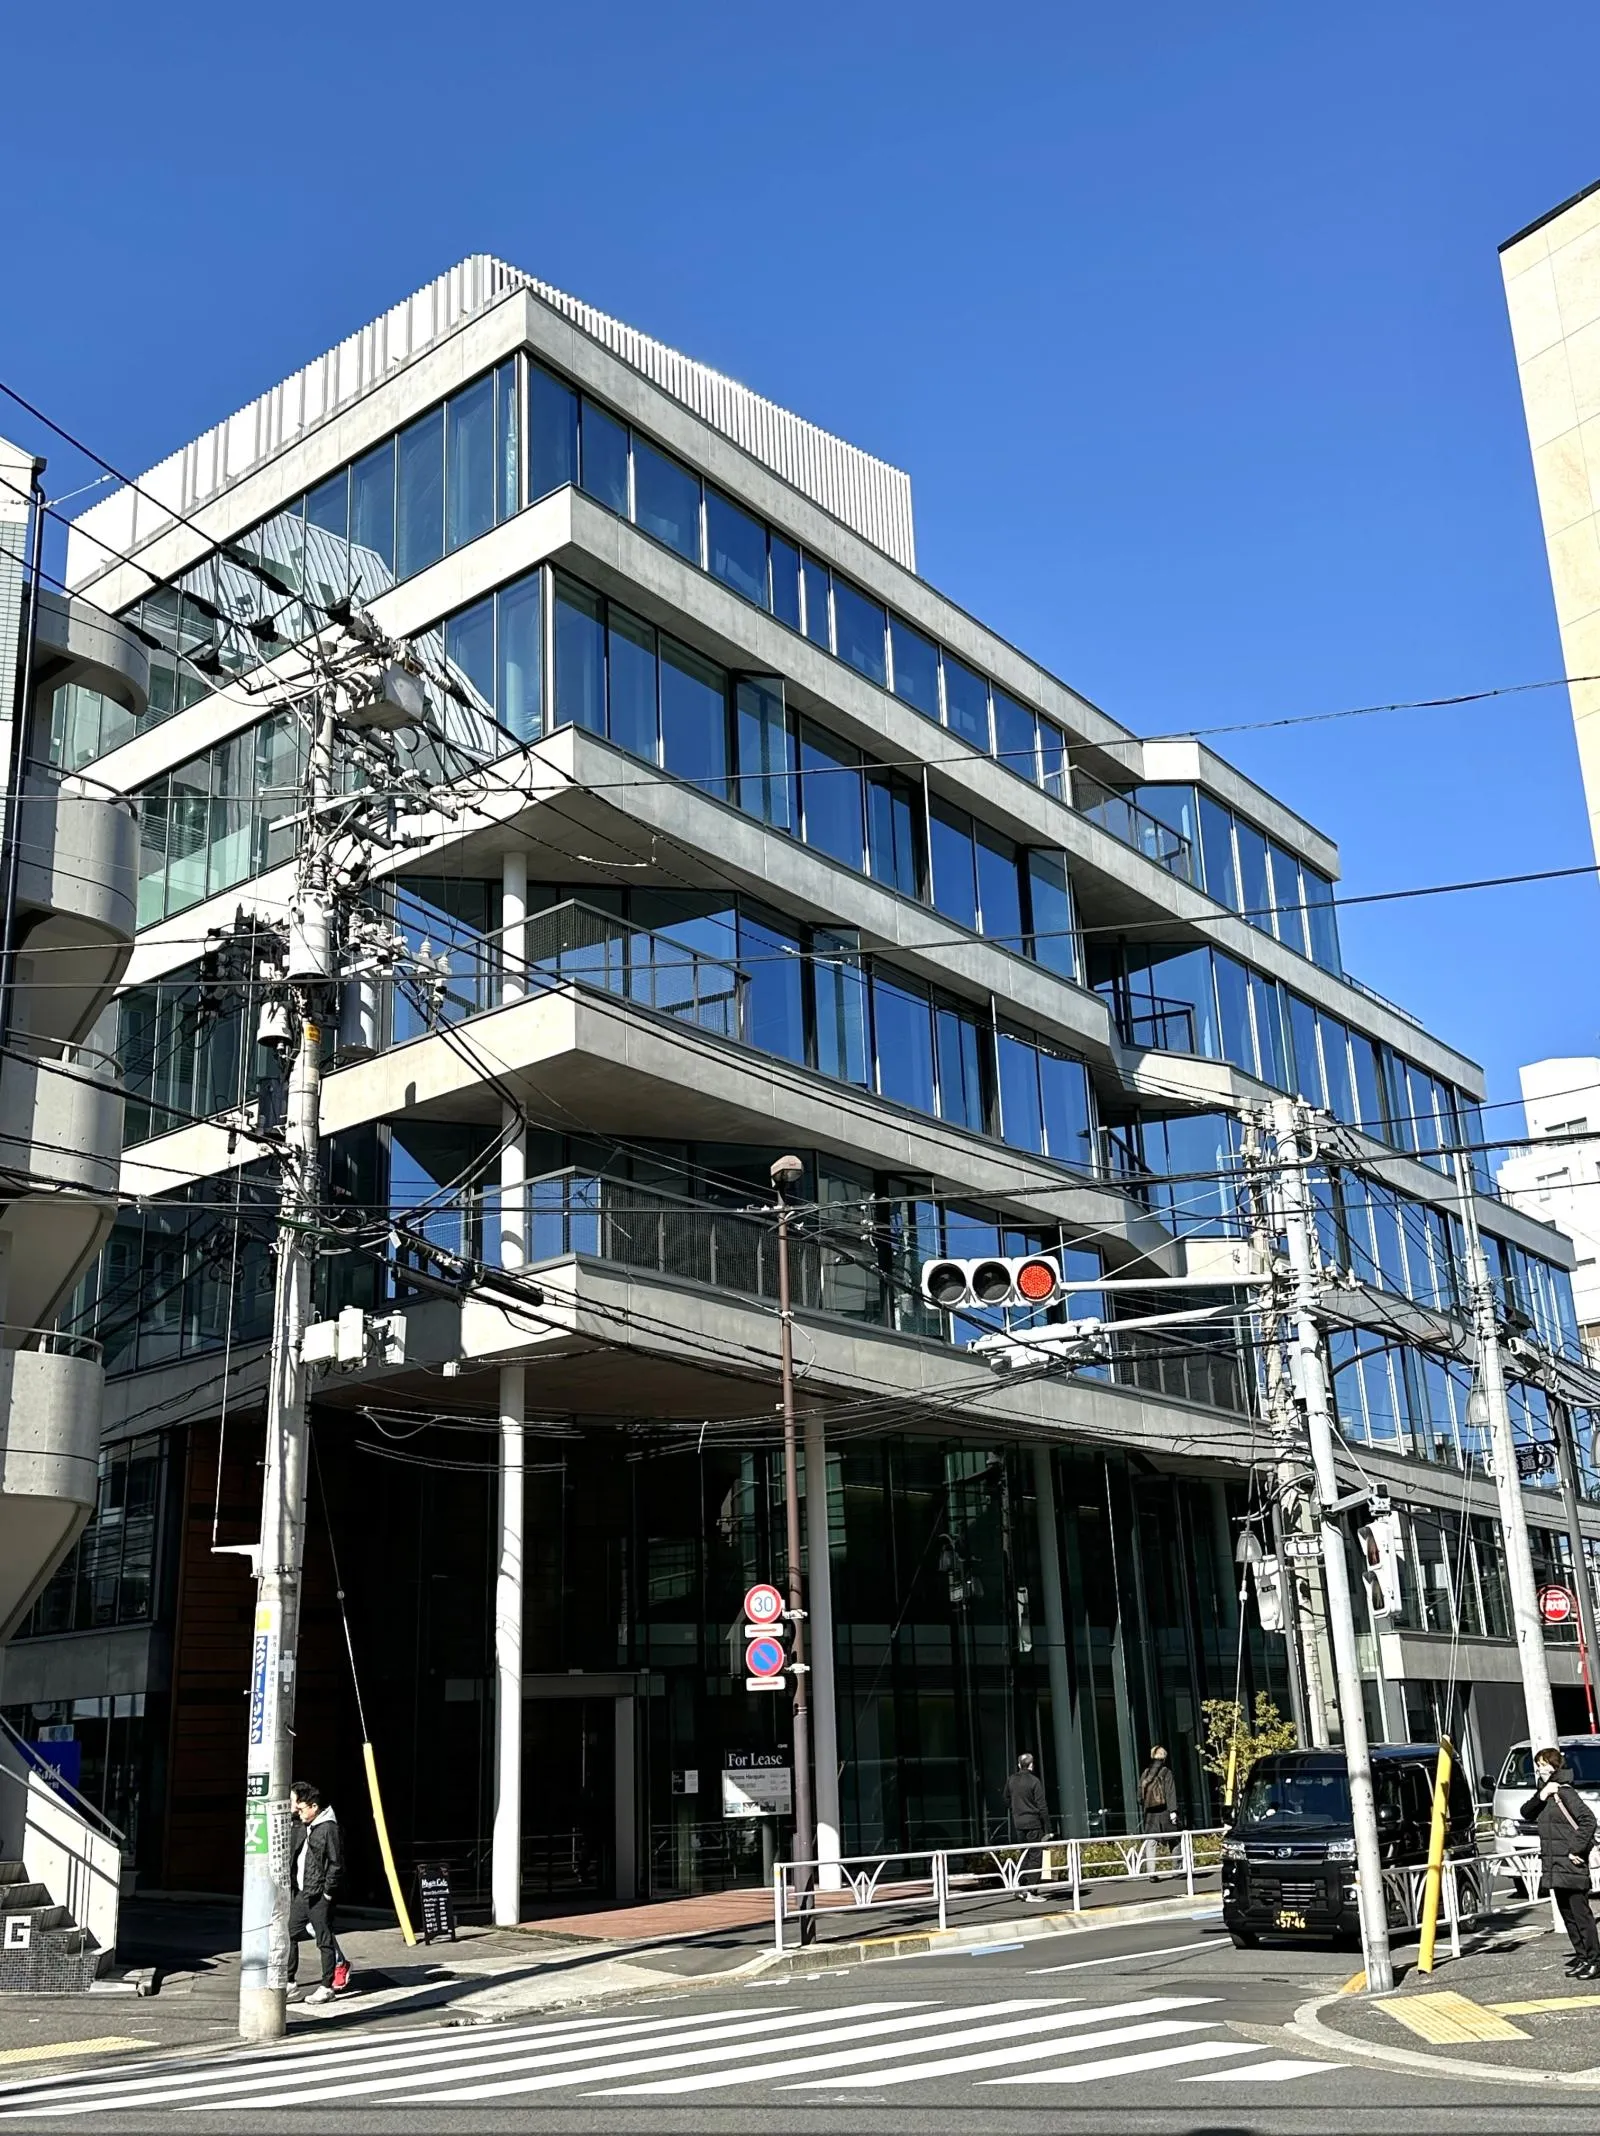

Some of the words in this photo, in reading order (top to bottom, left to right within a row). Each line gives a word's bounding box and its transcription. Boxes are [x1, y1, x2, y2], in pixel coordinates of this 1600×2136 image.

[754, 1596, 773, 1612] 30
[728, 1753, 748, 1767] For
[750, 1752, 783, 1766] Lease
